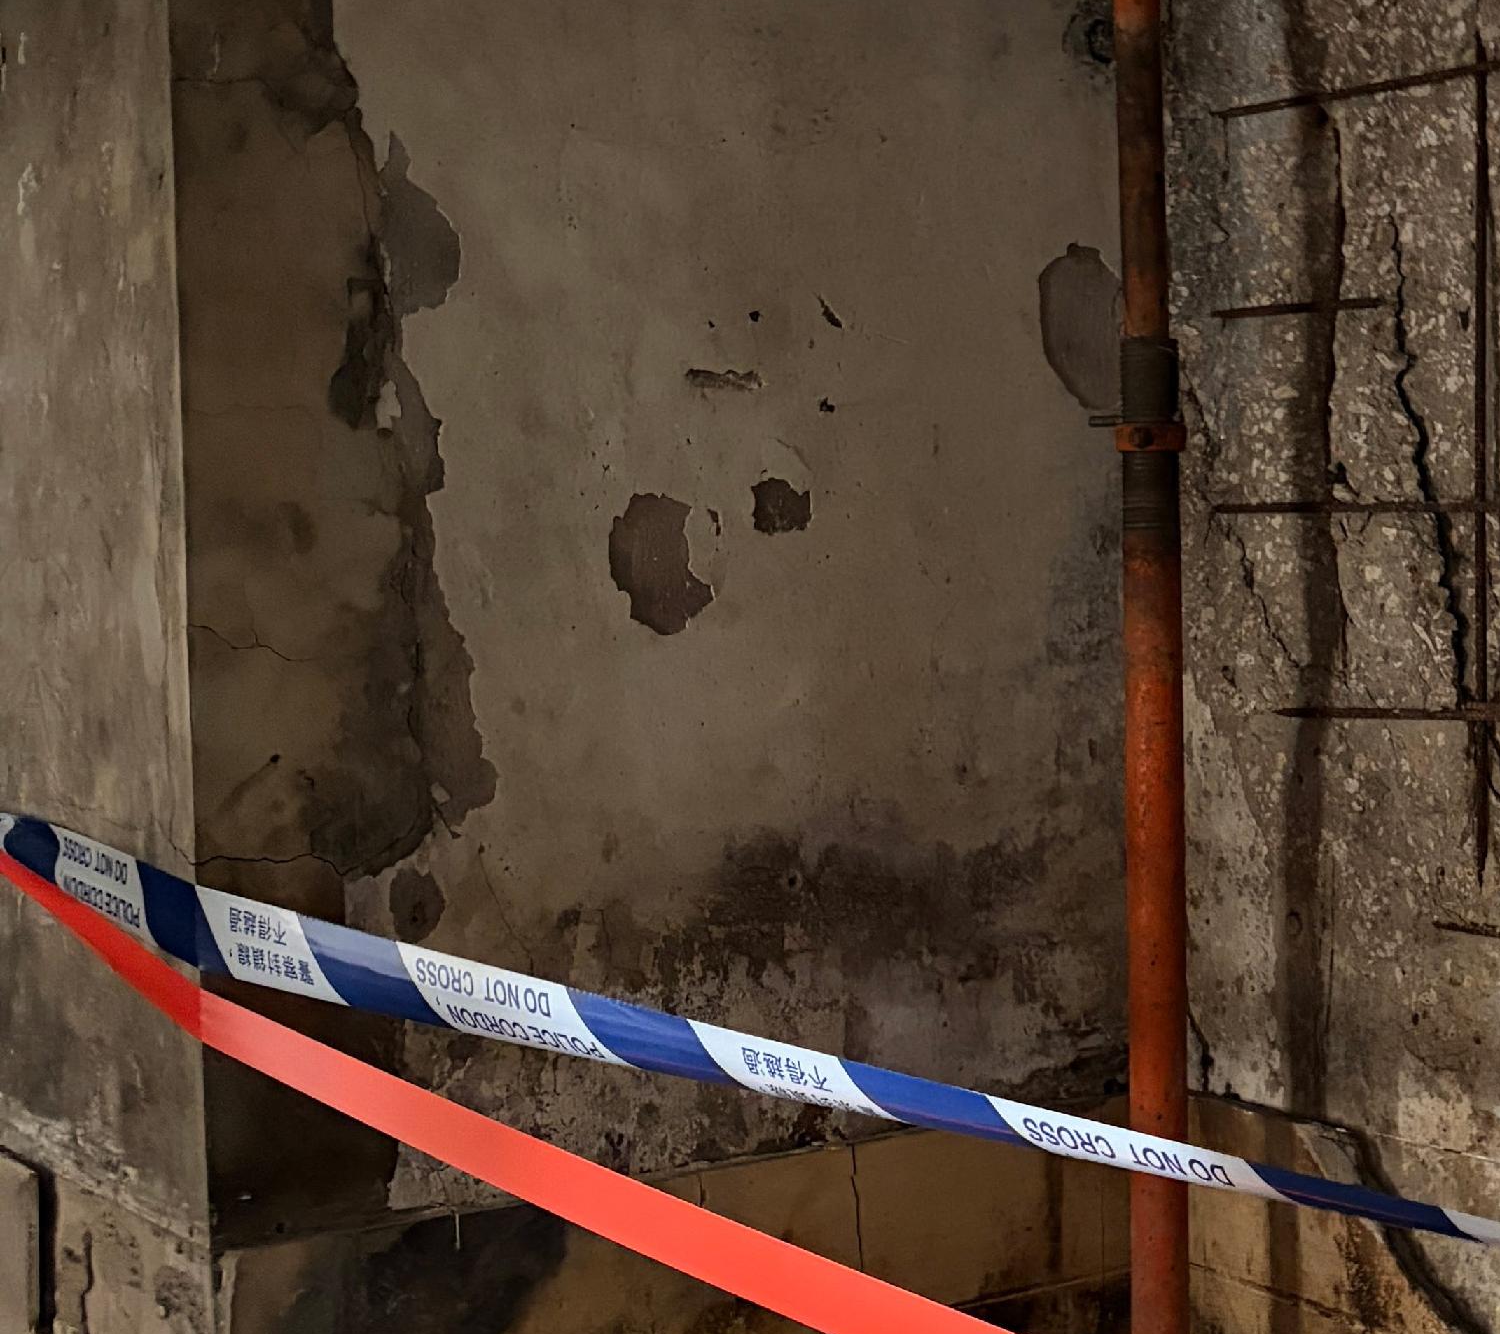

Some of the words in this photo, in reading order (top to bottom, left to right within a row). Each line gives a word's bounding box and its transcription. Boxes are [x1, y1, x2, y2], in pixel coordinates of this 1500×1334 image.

[416, 957, 474, 997] CROSS
[484, 977, 520, 1010] NOT
[523, 986, 552, 1019] DO
[532, 1024, 607, 1060] POLICE
[741, 1046, 834, 1093] 不得越過
[1021, 1117, 1117, 1159] CROSS
[1129, 1142, 1188, 1176] NOT
[1188, 1158, 1236, 1188] DO
